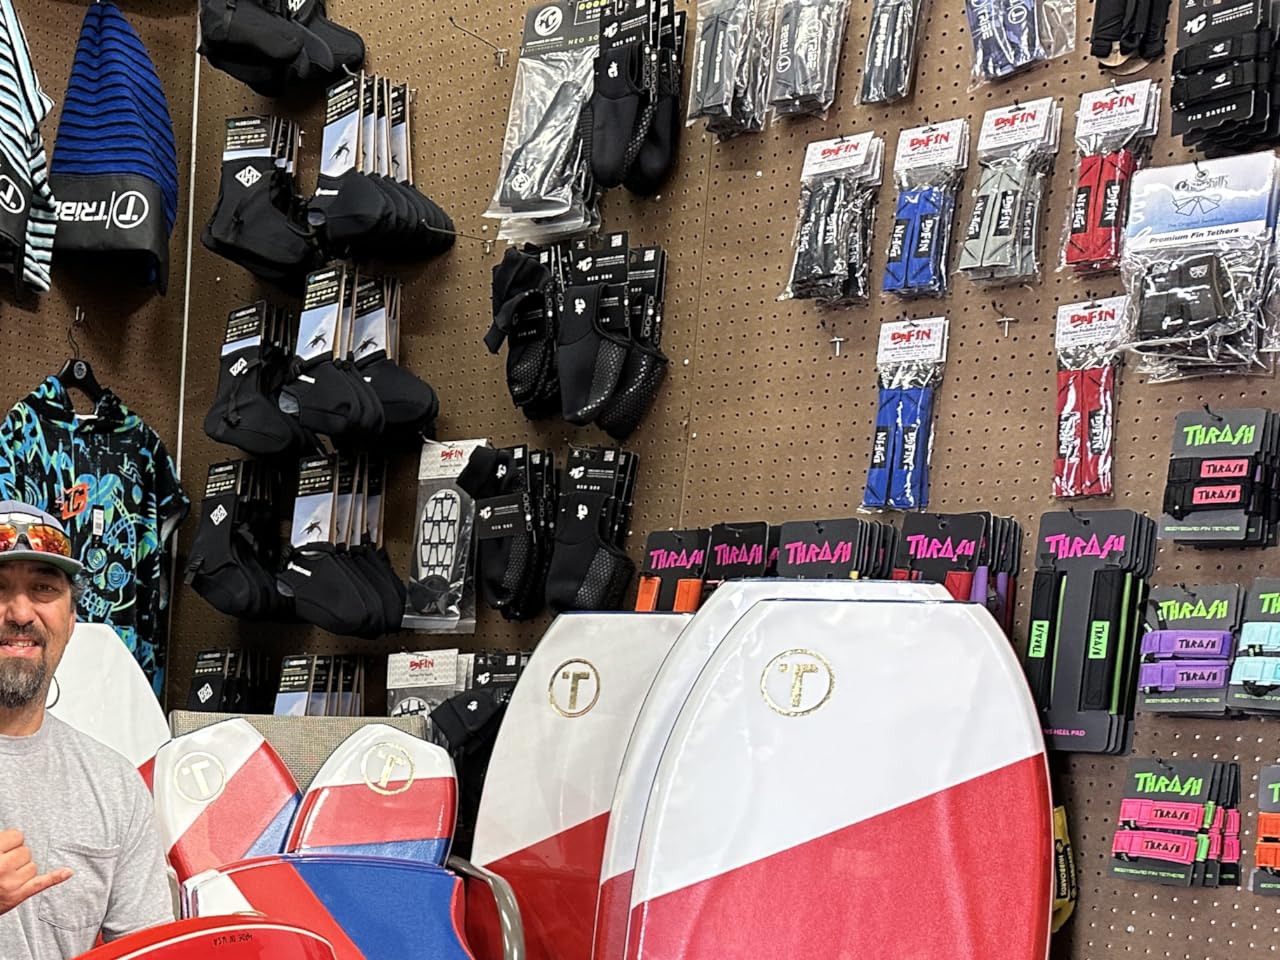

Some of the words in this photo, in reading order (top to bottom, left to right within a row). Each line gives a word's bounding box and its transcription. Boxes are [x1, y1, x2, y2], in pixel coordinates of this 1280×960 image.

[1187, 112, 1206, 122] FIN
[1209, 104, 1238, 117] SAVERS
[1149, 233, 1188, 244] Premium
[1190, 230, 1205, 238] Fin
[1206, 227, 1239, 236] Tethers
[1183, 424, 1256, 446] THRASH
[1205, 464, 1244, 474] THRASH
[1198, 490, 1237, 501] THRASH
[714, 543, 764, 565] THRASH
[784, 541, 853, 565] THRASH
[907, 534, 976, 562] THRASH
[1045, 534, 1125, 560] THRASH
[649, 548, 705, 569] THRASH
[1158, 599, 1228, 621] THRASH
[1033, 624, 1045, 655] THRASH
[1092, 624, 1105, 656] THRASH
[1179, 639, 1217, 649] THRASH
[1179, 672, 1218, 682] THRASH
[1135, 772, 1203, 797] THRASH
[1153, 808, 1190, 821] THRASH
[1144, 840, 1181, 854] THRASH
